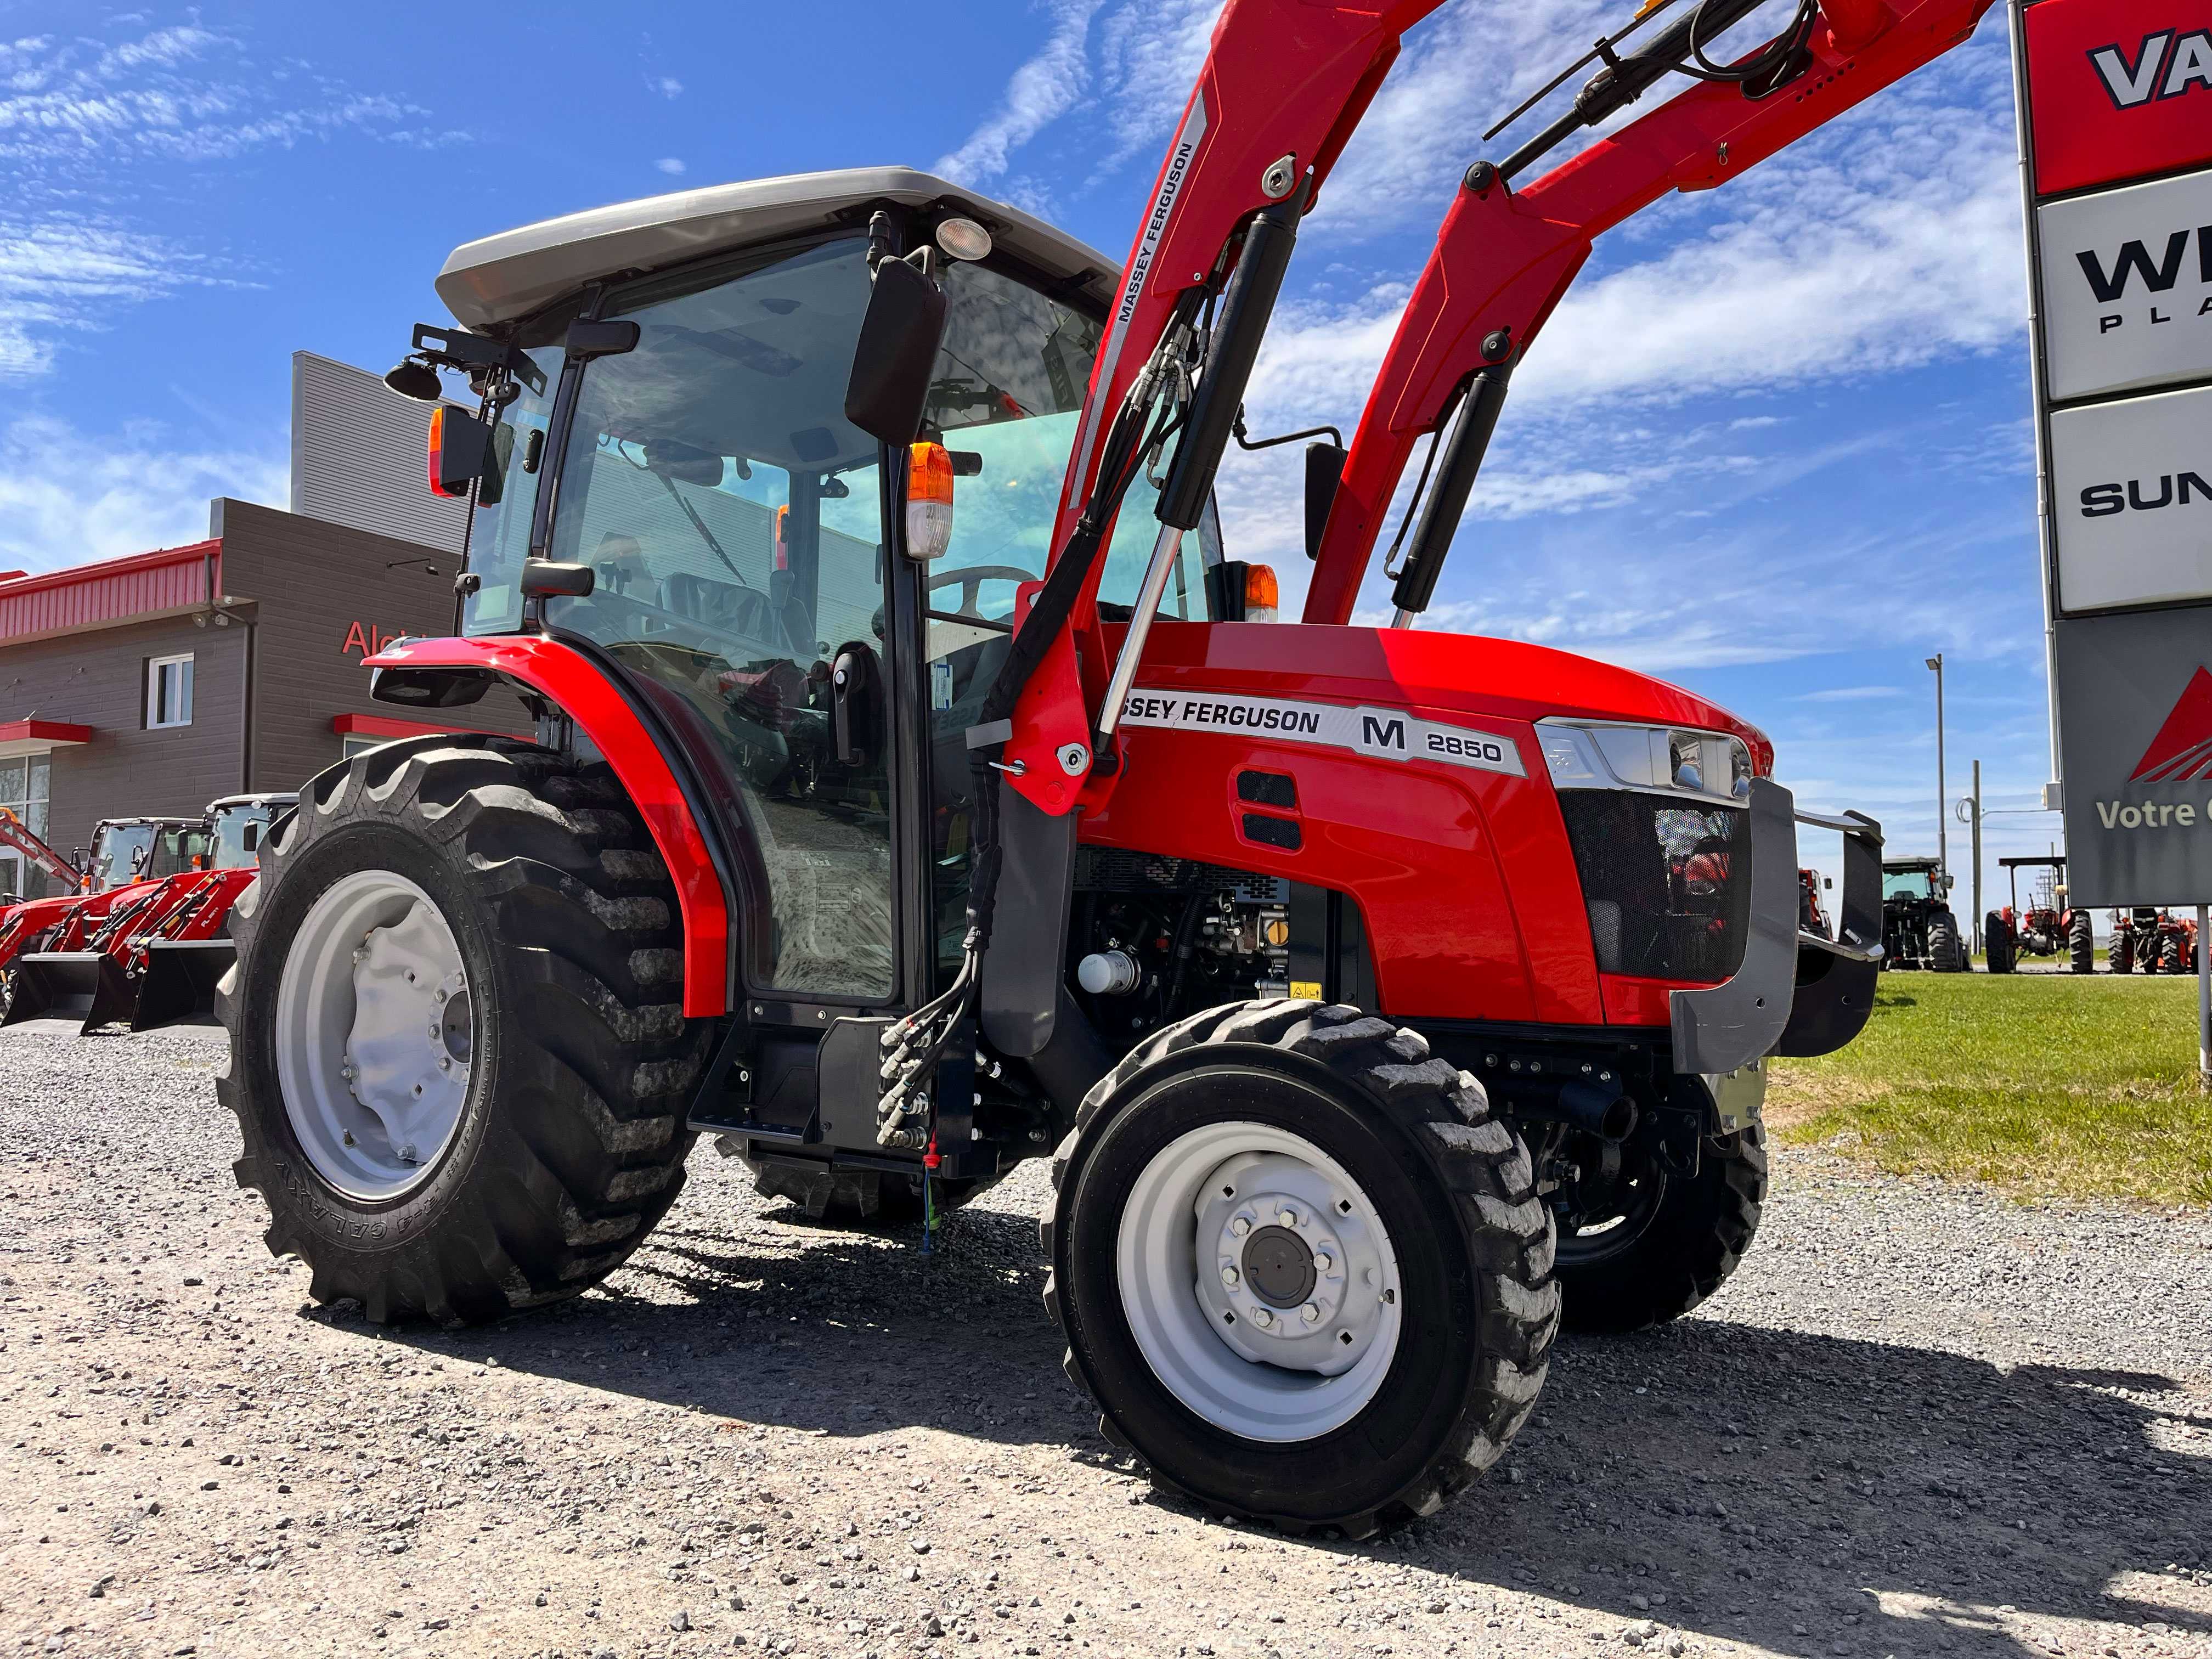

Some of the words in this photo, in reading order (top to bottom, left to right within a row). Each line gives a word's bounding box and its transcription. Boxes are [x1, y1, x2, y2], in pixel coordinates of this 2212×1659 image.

[1119, 246, 1152, 323] MASSEY
[1147, 143, 1192, 241] FERGUSON
[1183, 702, 1320, 733] FERGUSON
[1363, 716, 1405, 750] M
[1427, 732, 1502, 763] 2850
[2096, 800, 2196, 829] Votre
[273, 1161, 387, 1240] GALAXY
